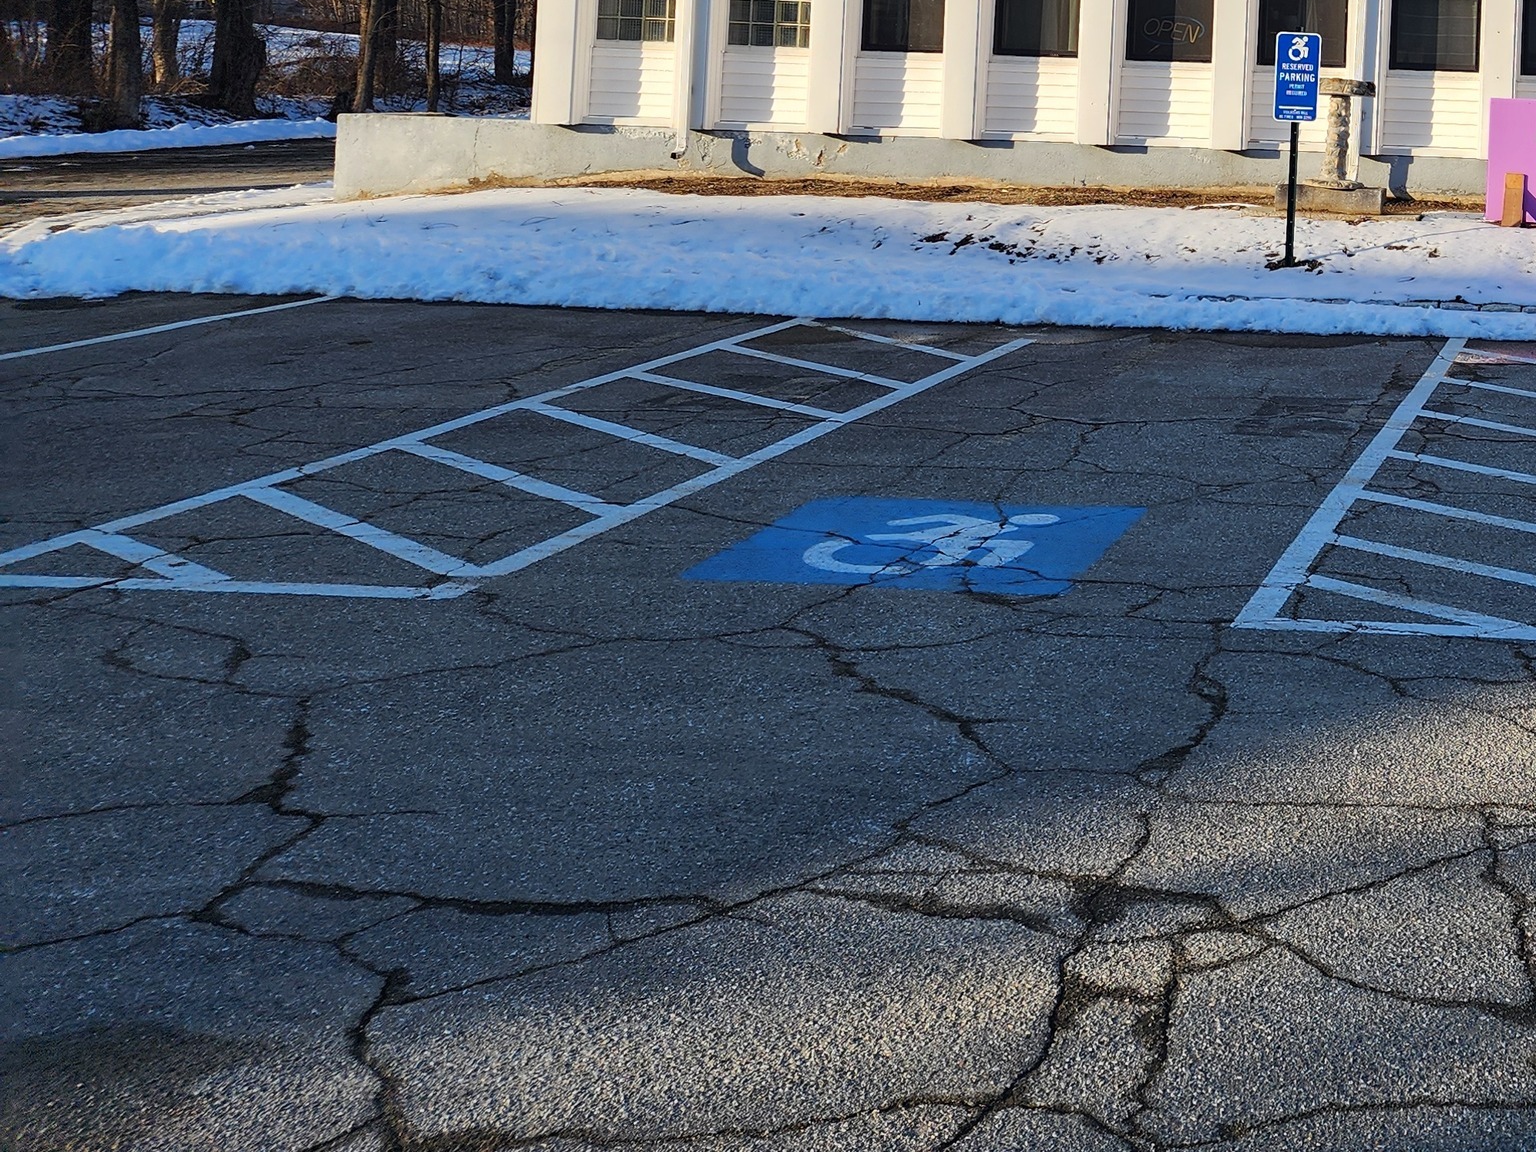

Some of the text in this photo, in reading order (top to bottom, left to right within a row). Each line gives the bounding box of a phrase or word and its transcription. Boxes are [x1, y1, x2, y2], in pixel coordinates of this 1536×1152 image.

[1143, 17, 1200, 43] OPEN
[1281, 62, 1314, 71] RESERVED
[1279, 72, 1315, 82] PARKING
